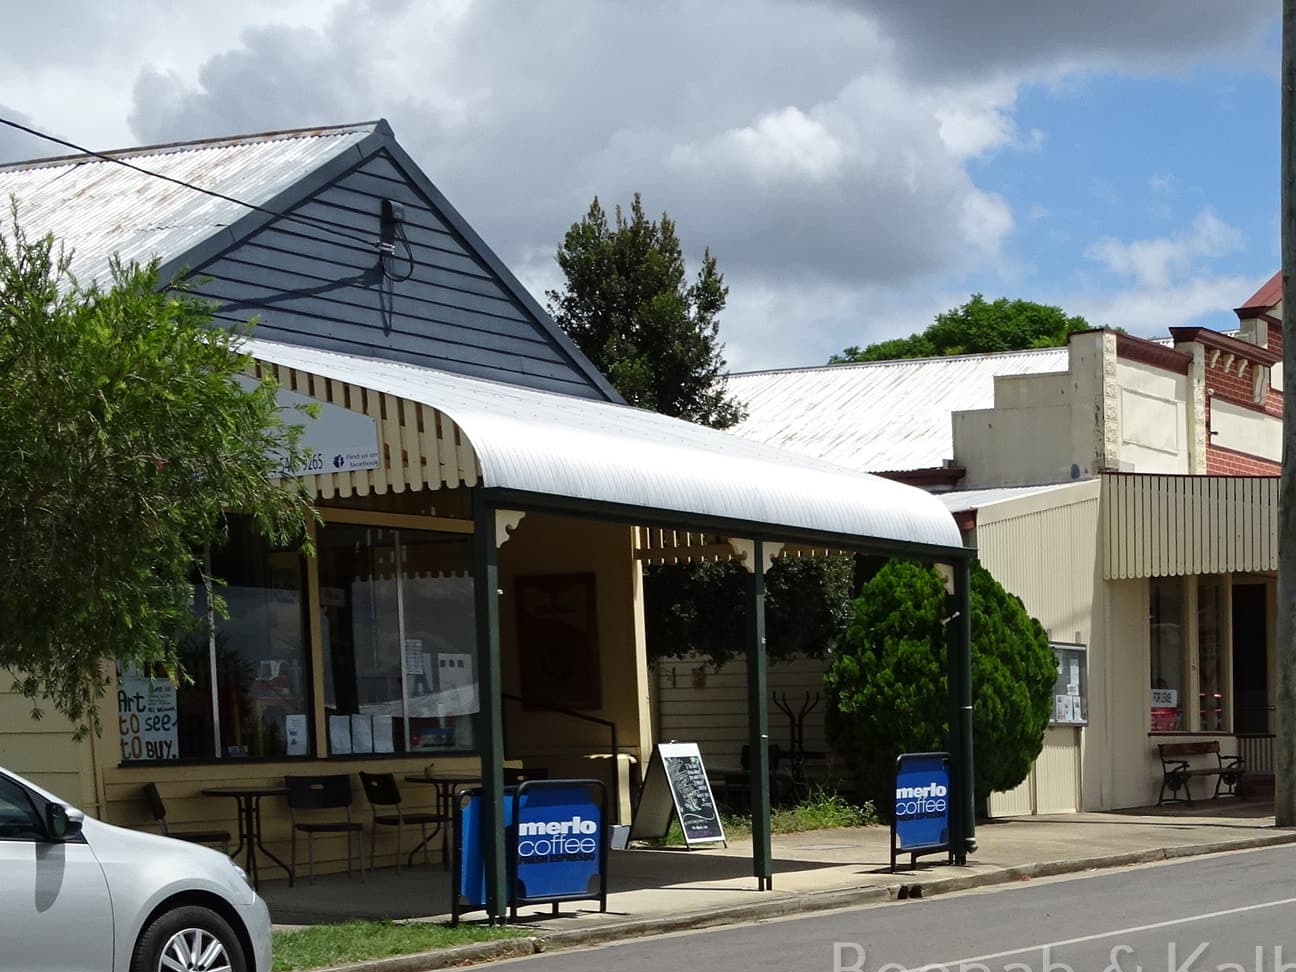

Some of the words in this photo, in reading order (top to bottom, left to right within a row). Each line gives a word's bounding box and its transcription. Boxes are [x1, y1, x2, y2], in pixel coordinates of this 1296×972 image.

[117, 690, 146, 712] Art
[896, 782, 947, 799] merlo
[896, 798, 946, 815] coffee
[518, 816, 597, 836] merlo
[518, 834, 596, 857] coffee
